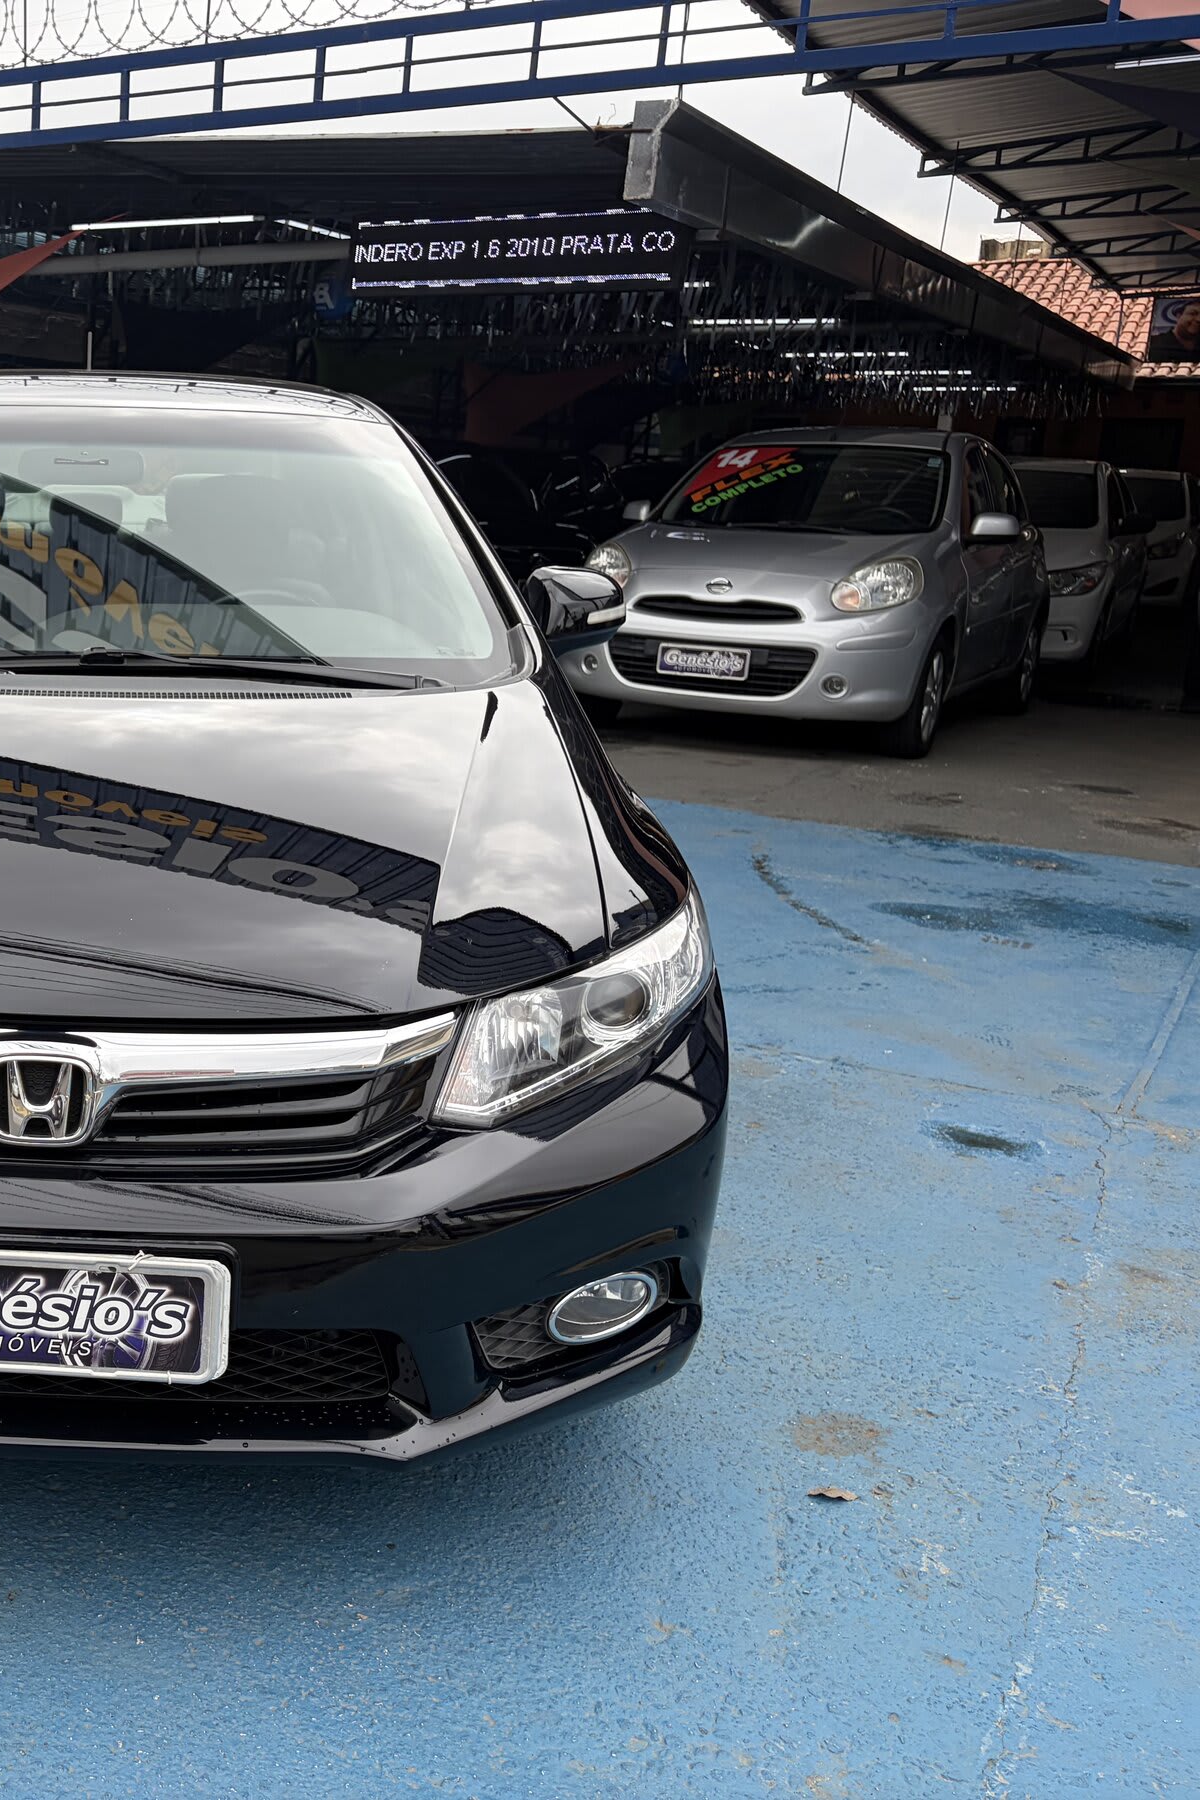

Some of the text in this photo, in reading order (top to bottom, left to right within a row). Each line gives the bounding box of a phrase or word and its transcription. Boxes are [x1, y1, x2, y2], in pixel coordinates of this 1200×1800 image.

[428, 240, 466, 261] EXP
[471, 239, 501, 259] 1.6
[505, 237, 556, 257] 2010
[560, 233, 634, 255] PRATA
[641, 230, 676, 252] CO
[690, 453, 795, 503] FLEX
[717, 449, 758, 468] 14
[691, 464, 803, 513] COMPLETO
